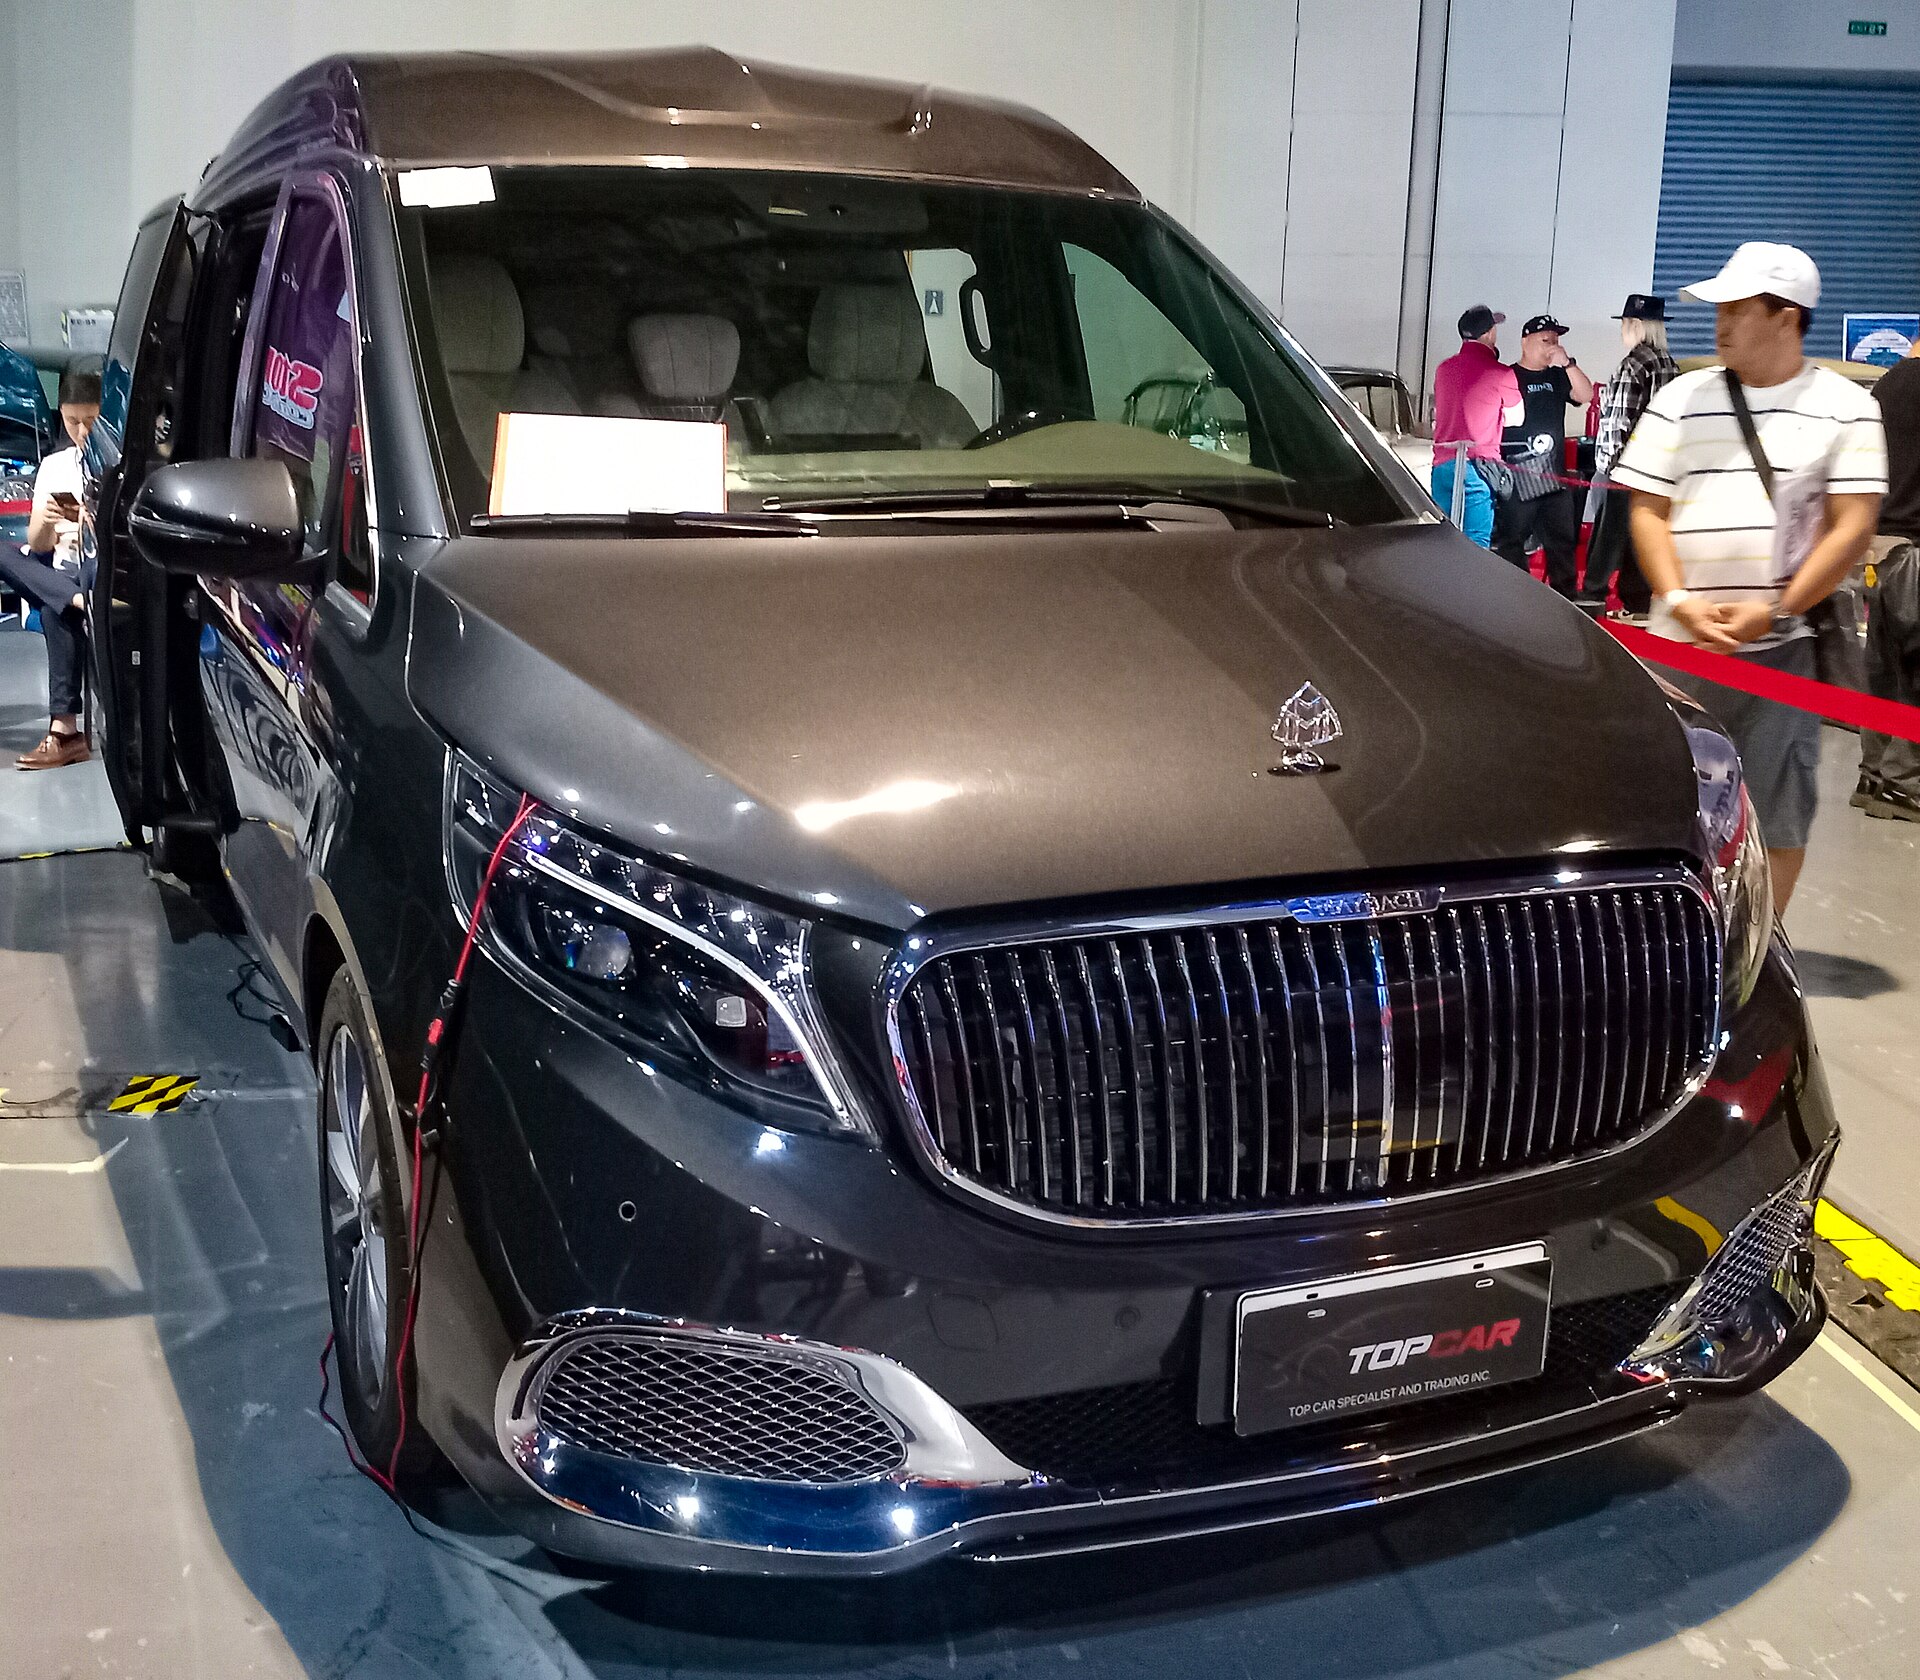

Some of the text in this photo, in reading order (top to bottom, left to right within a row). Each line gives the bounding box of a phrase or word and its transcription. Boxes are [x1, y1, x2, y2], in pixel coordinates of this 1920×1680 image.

[1288, 1404, 1312, 1418] TOP
[1312, 1399, 1336, 1414] CAR
[1336, 1387, 1397, 1409] SPECIALIST
[1398, 1383, 1422, 1397] AND
[1423, 1373, 1470, 1392] TRADING
